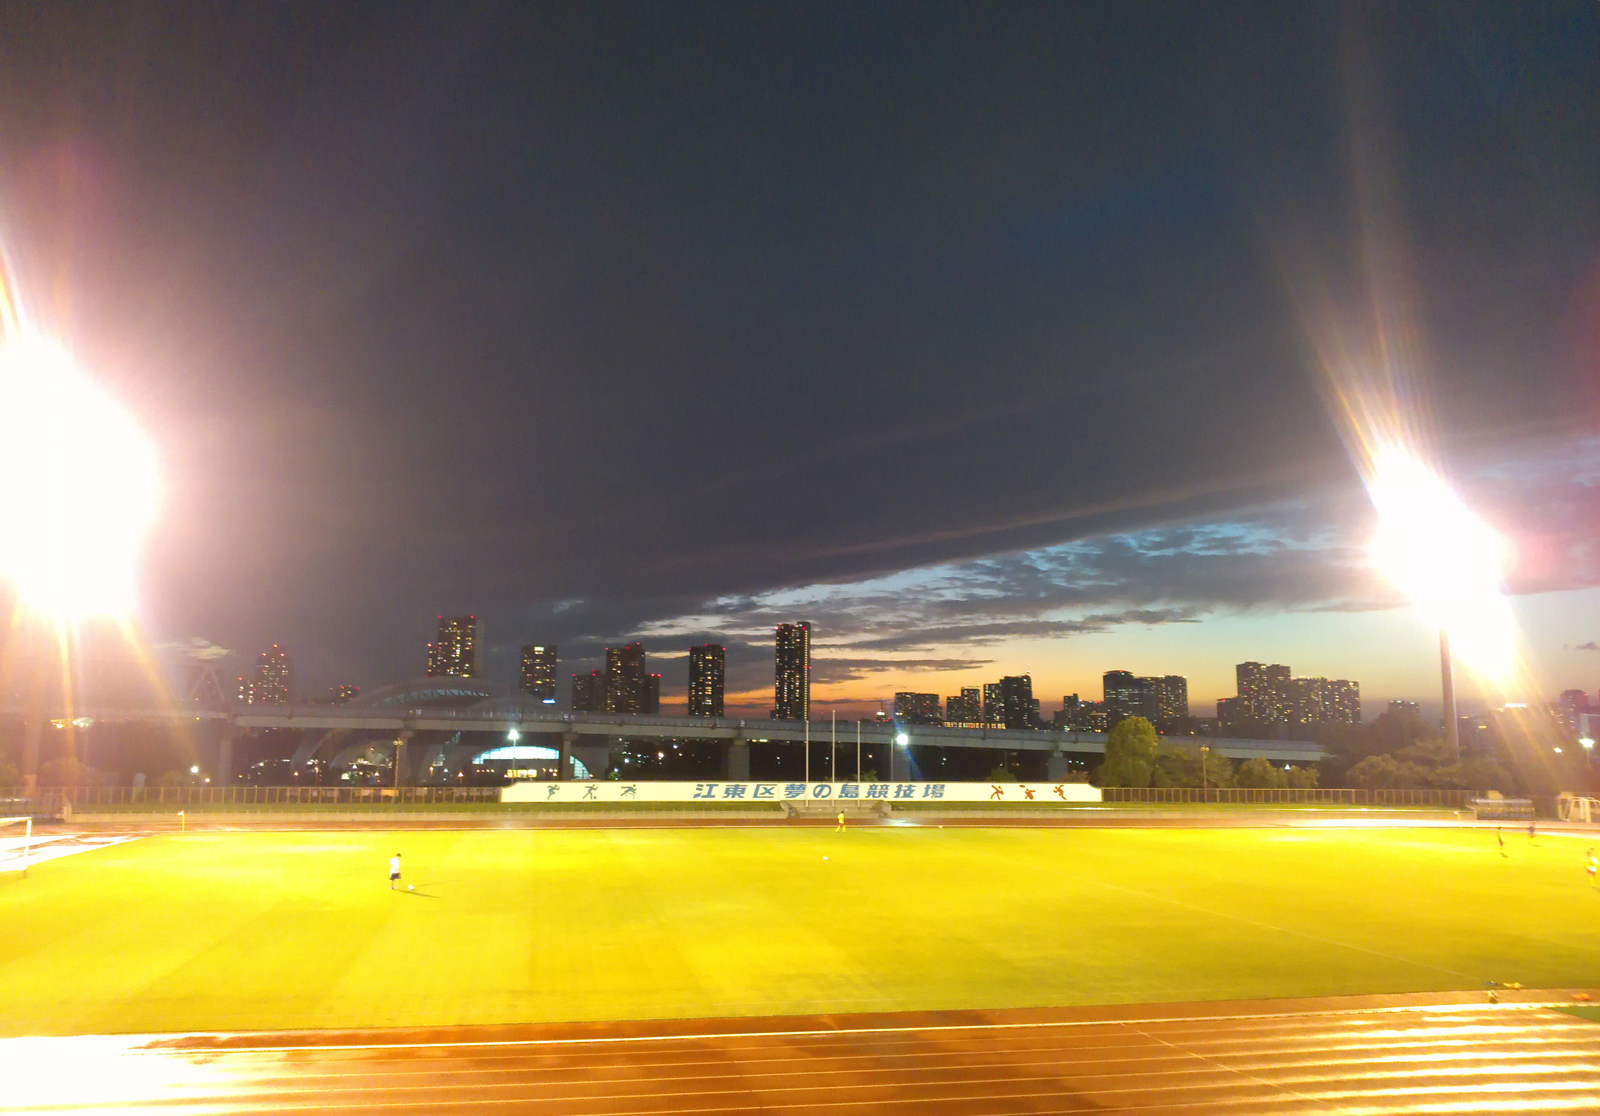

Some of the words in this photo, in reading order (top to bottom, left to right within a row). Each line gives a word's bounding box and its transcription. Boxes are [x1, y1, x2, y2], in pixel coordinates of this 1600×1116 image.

[693, 784, 946, 799] 江東区夢の島競技場
